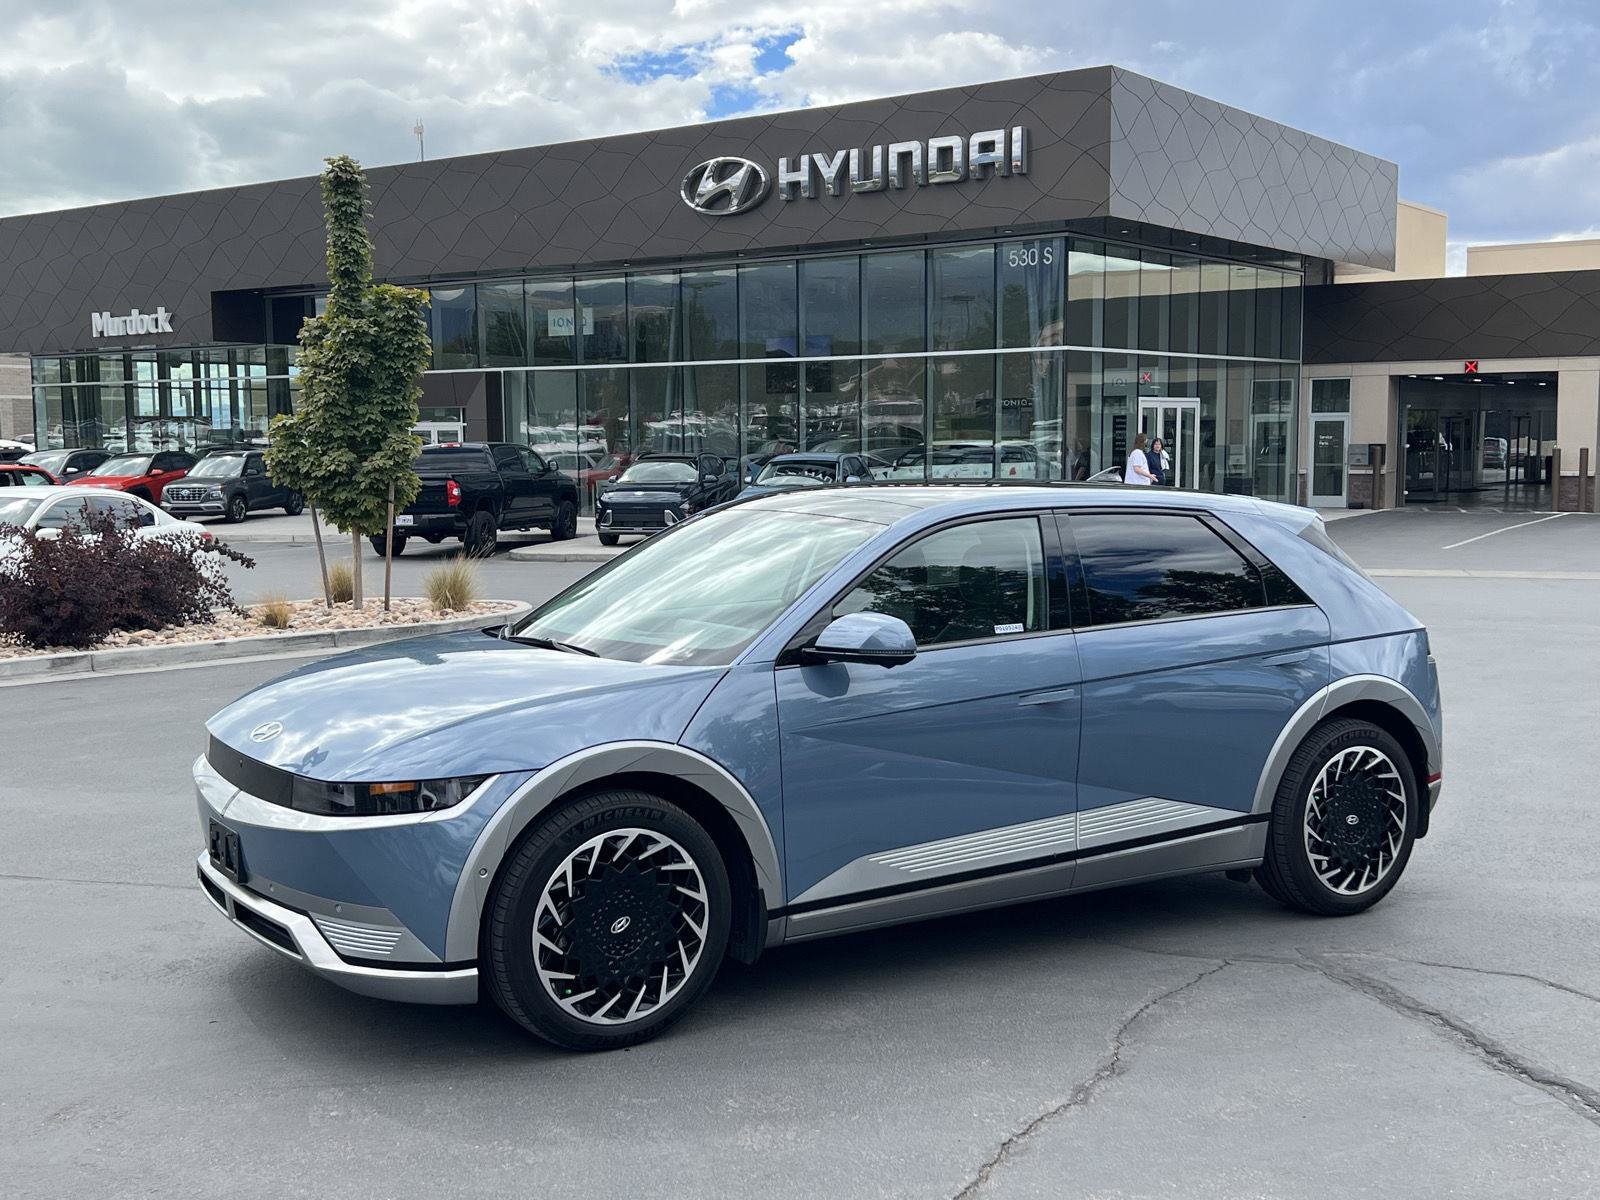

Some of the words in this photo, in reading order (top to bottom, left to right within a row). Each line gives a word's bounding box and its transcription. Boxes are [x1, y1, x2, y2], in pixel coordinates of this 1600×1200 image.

[778, 125, 1028, 201] HYUNDAI
[1008, 248, 1038, 267] 530
[1043, 246, 1053, 265] S
[91, 306, 174, 338] Murdock
[583, 806, 660, 830] MICHELIN
